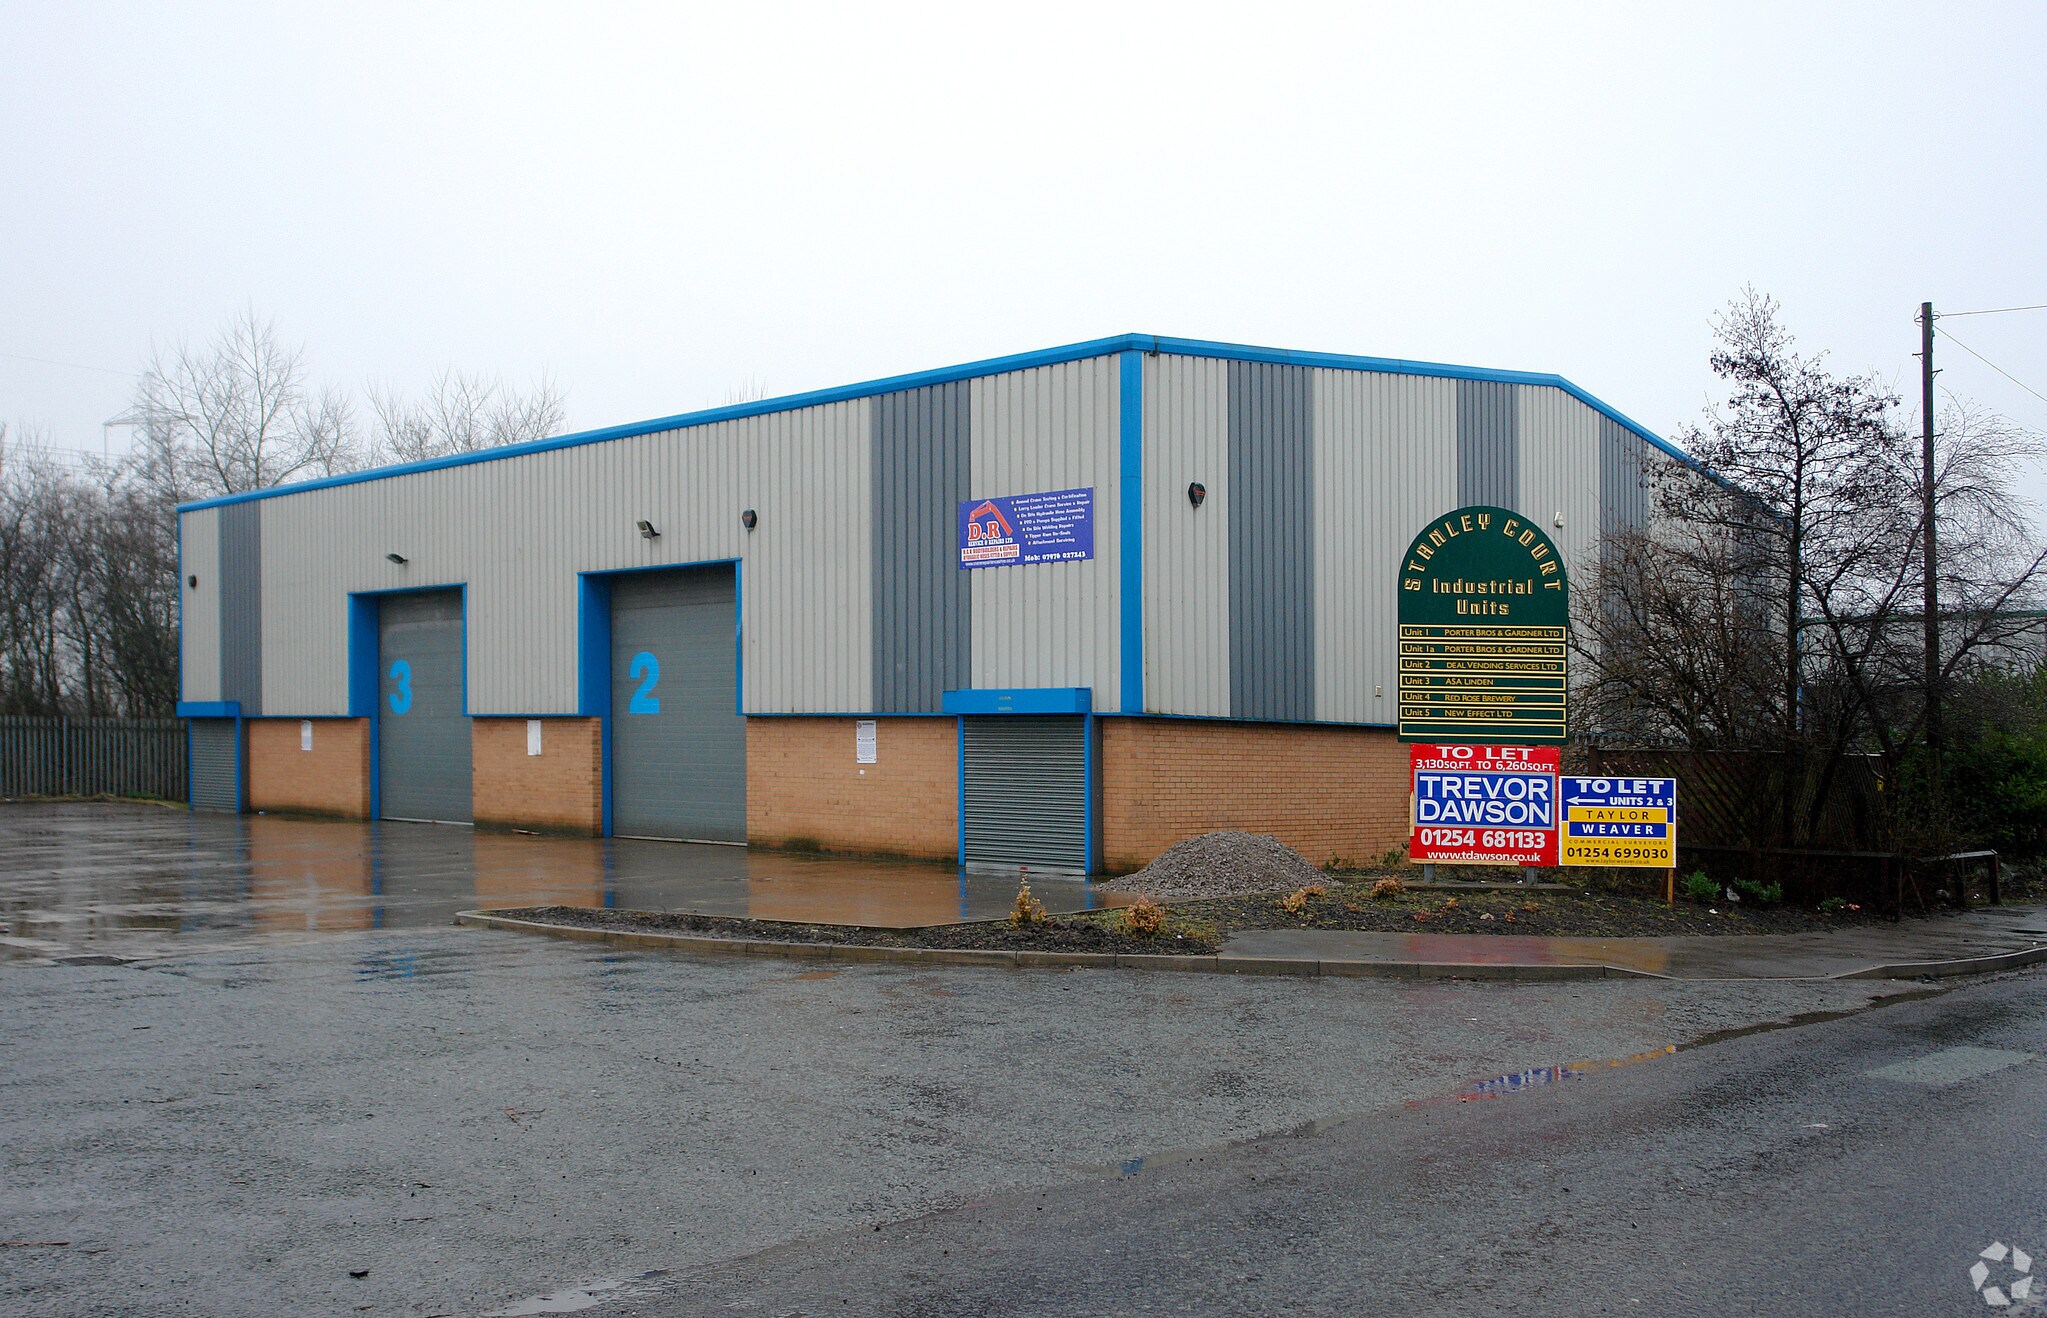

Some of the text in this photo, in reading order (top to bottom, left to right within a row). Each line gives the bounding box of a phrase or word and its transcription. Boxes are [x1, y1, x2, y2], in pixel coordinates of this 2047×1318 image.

[968, 520, 1001, 541] D.R
[1404, 513, 1562, 591] STANLEY COURT
[1432, 578, 1534, 594] Industrial
[1457, 599, 1510, 616] Units
[1467, 662, 1504, 670] VENDING
[389, 660, 412, 715] 3
[629, 652, 660, 714] 2
[1436, 746, 1534, 760] TO LET
[1476, 760, 1492, 770] TO
[1420, 776, 1549, 801] TREVOR
[1576, 779, 1664, 794] TO LET
[1610, 797, 1643, 806] UNITS
[1646, 797, 1654, 806] 2
[1667, 798, 1673, 806] 3
[1419, 799, 1550, 824] DAWSON
[1586, 810, 1649, 820] TAYLOR
[1582, 824, 1654, 834] WEAVER
[1420, 828, 1546, 848] 01254 681133
[1427, 851, 1541, 862] www.tdawson.co.uk
[1567, 847, 1668, 858] 01254 699030
